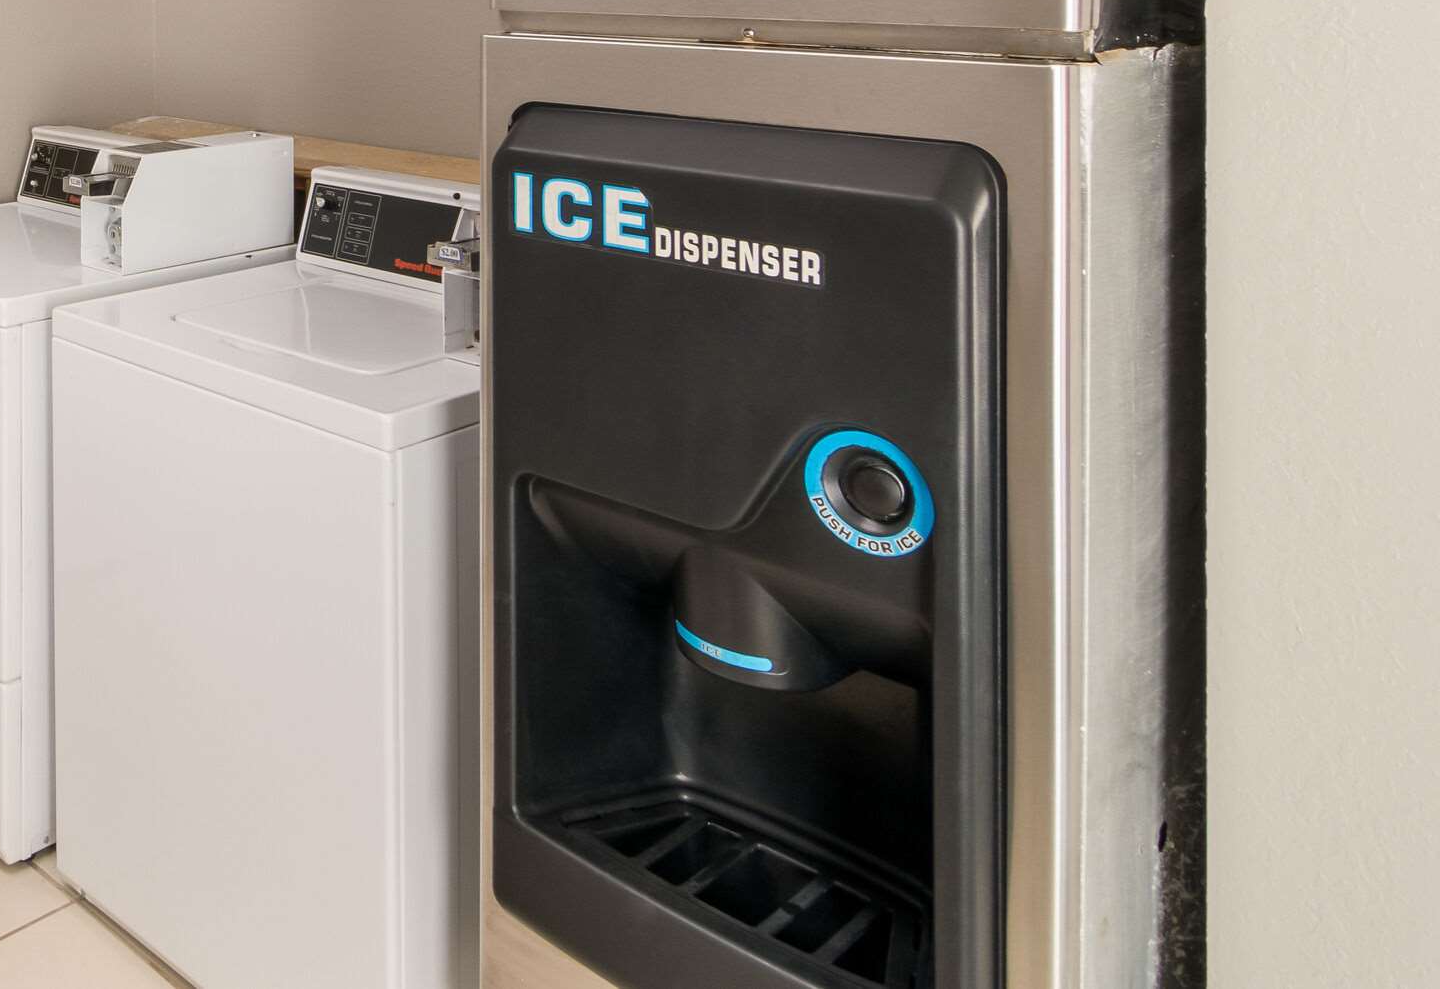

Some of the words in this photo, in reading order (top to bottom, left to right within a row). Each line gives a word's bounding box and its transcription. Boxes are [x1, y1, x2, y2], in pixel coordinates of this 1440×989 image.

[512, 172, 650, 254] ICE
[655, 227, 821, 286] DISPENSER
[812, 497, 852, 539] PUSH
[857, 537, 893, 553] FOR
[896, 530, 922, 551] ICE
